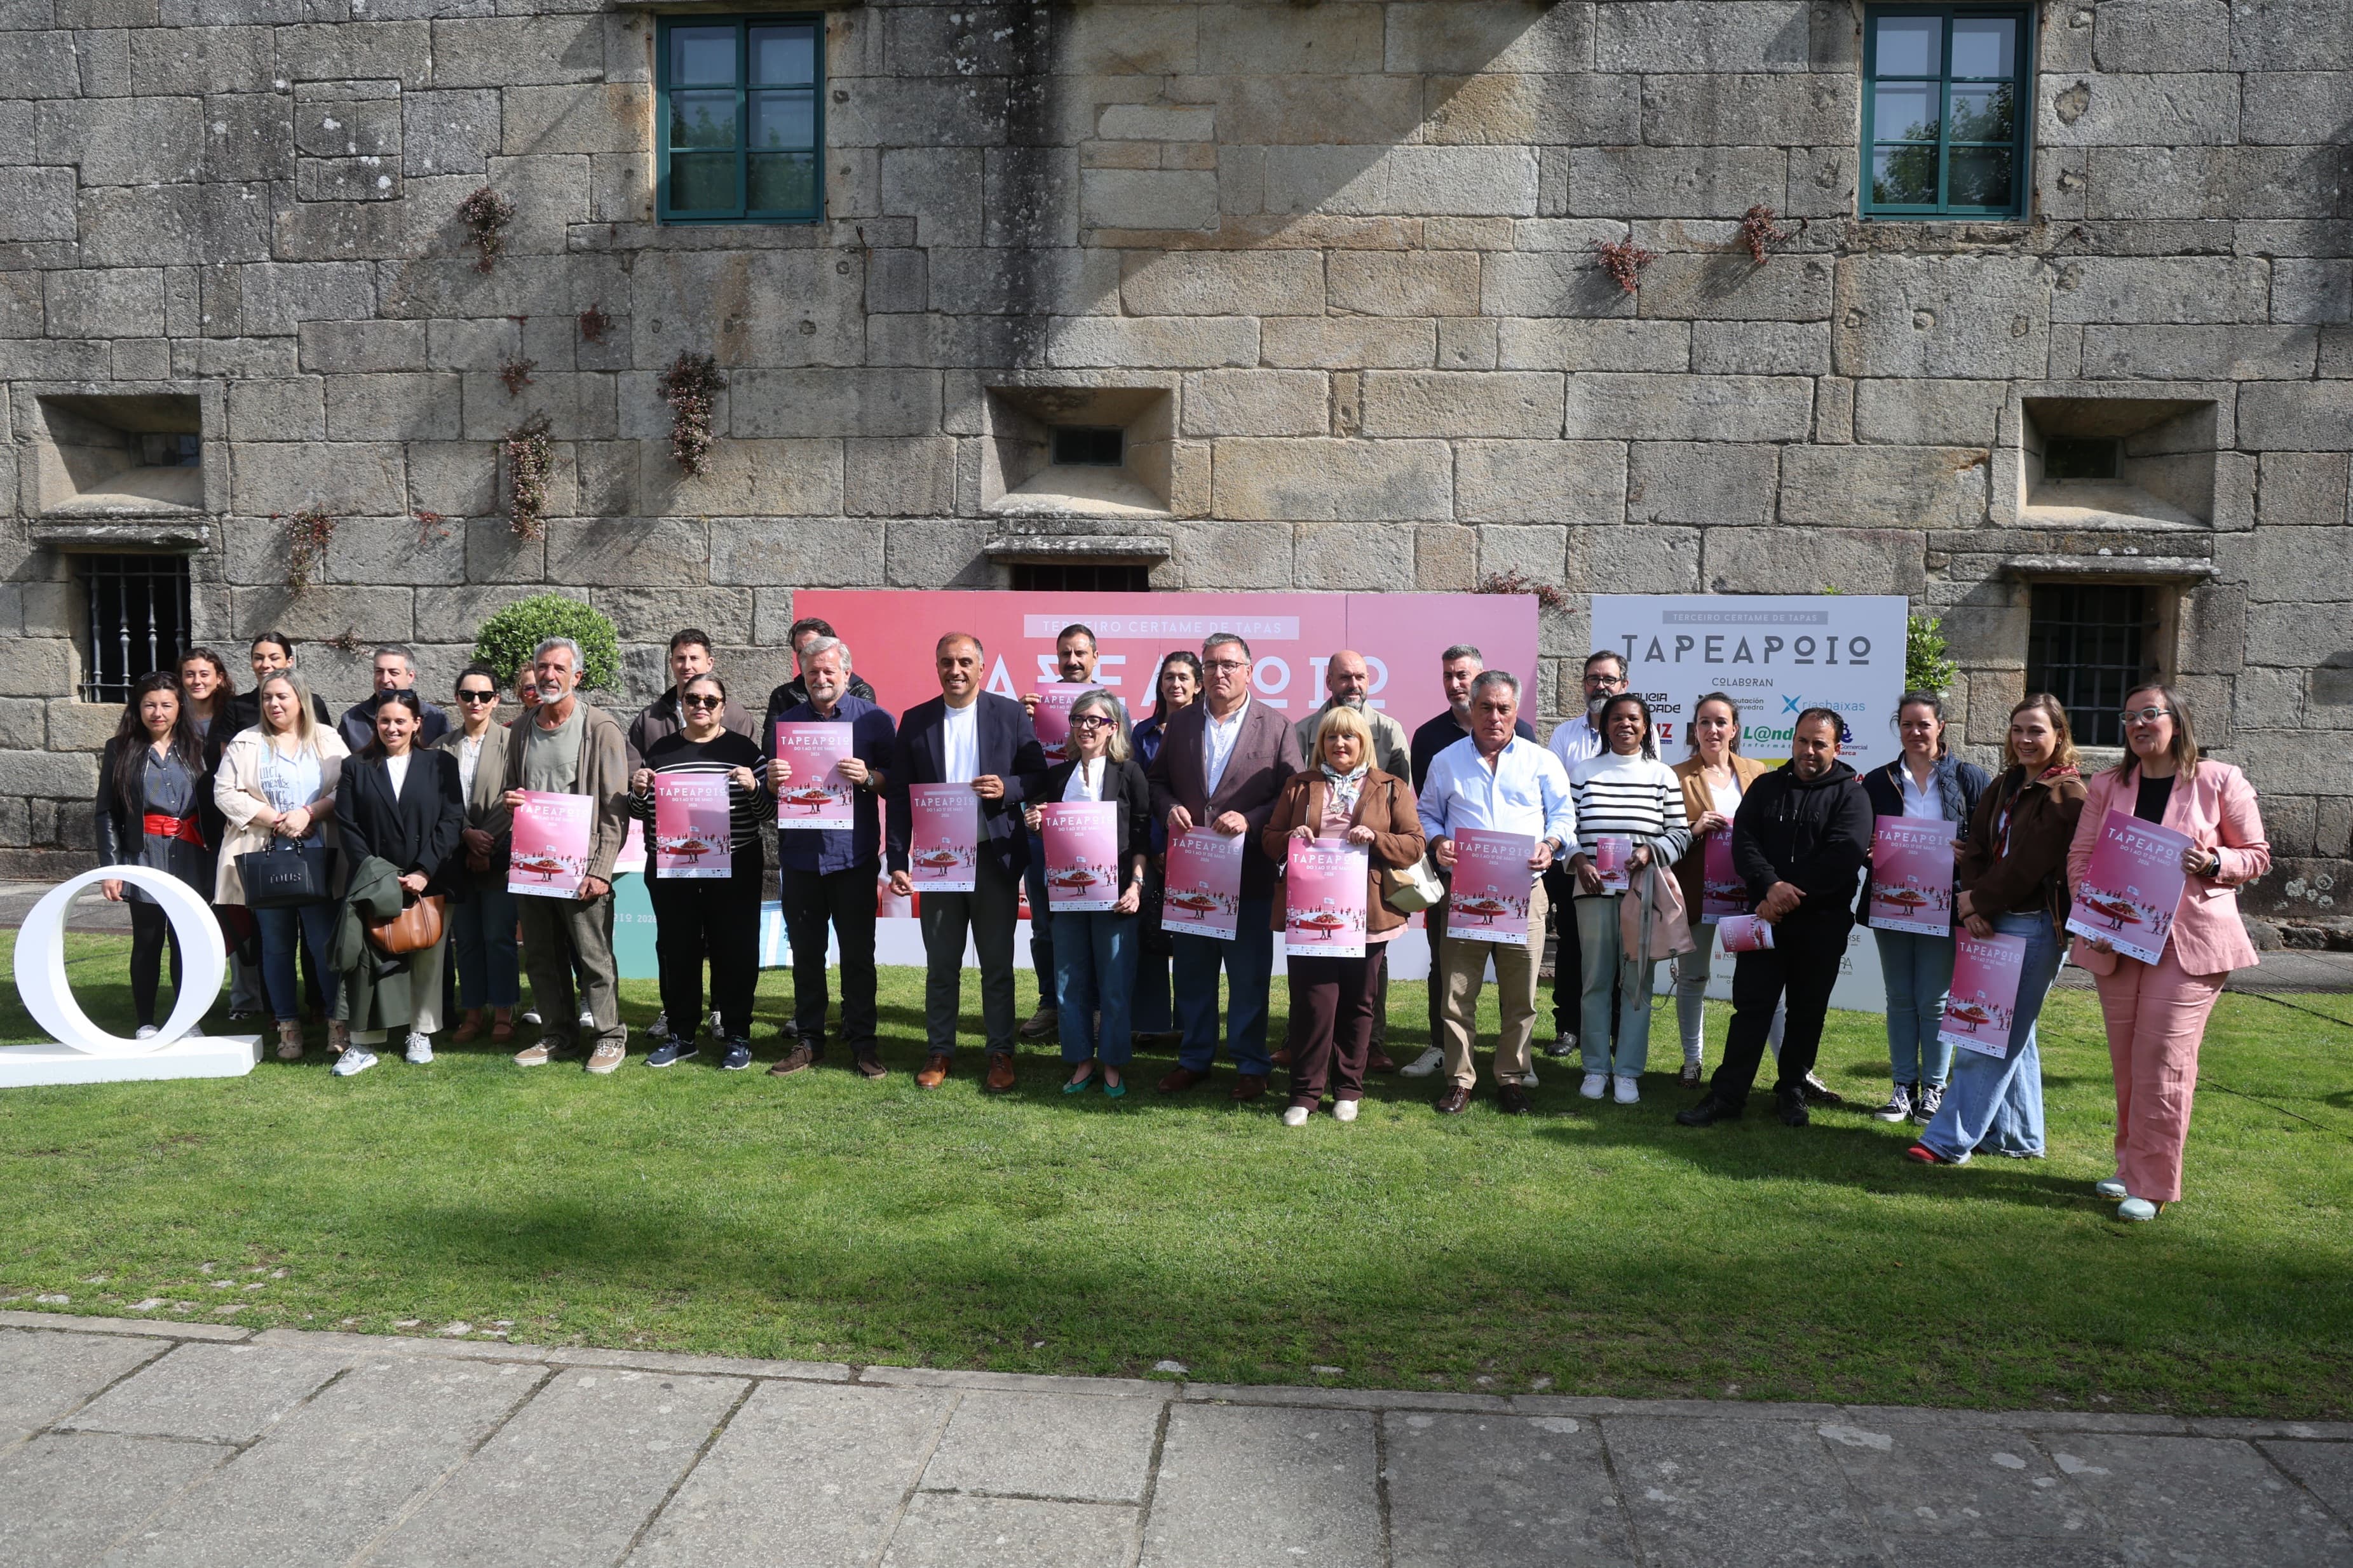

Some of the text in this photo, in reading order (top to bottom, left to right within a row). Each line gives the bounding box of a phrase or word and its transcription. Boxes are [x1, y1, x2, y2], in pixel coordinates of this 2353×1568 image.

[1043, 621, 1282, 634] TEREIRO CERTAME DE TAPAS
[1622, 634, 1871, 665] TAPEAPOIO
[781, 736, 850, 745] TAPEAPOIO
[659, 787, 726, 797] TAPEAPOIO
[914, 797, 974, 807] TAPEAPOIO
[1045, 815, 1115, 827] TAPEAPOIO
[1711, 831, 1732, 840] TAP
[1878, 830, 1952, 846] TAPEAPOIO
[1172, 838, 1240, 855] TAPEAPOIO
[1459, 842, 1531, 857] TAPEAPOIO
[2108, 827, 2181, 862] TAPEAPOI
[1960, 942, 2021, 963] TAPEAPOIO
